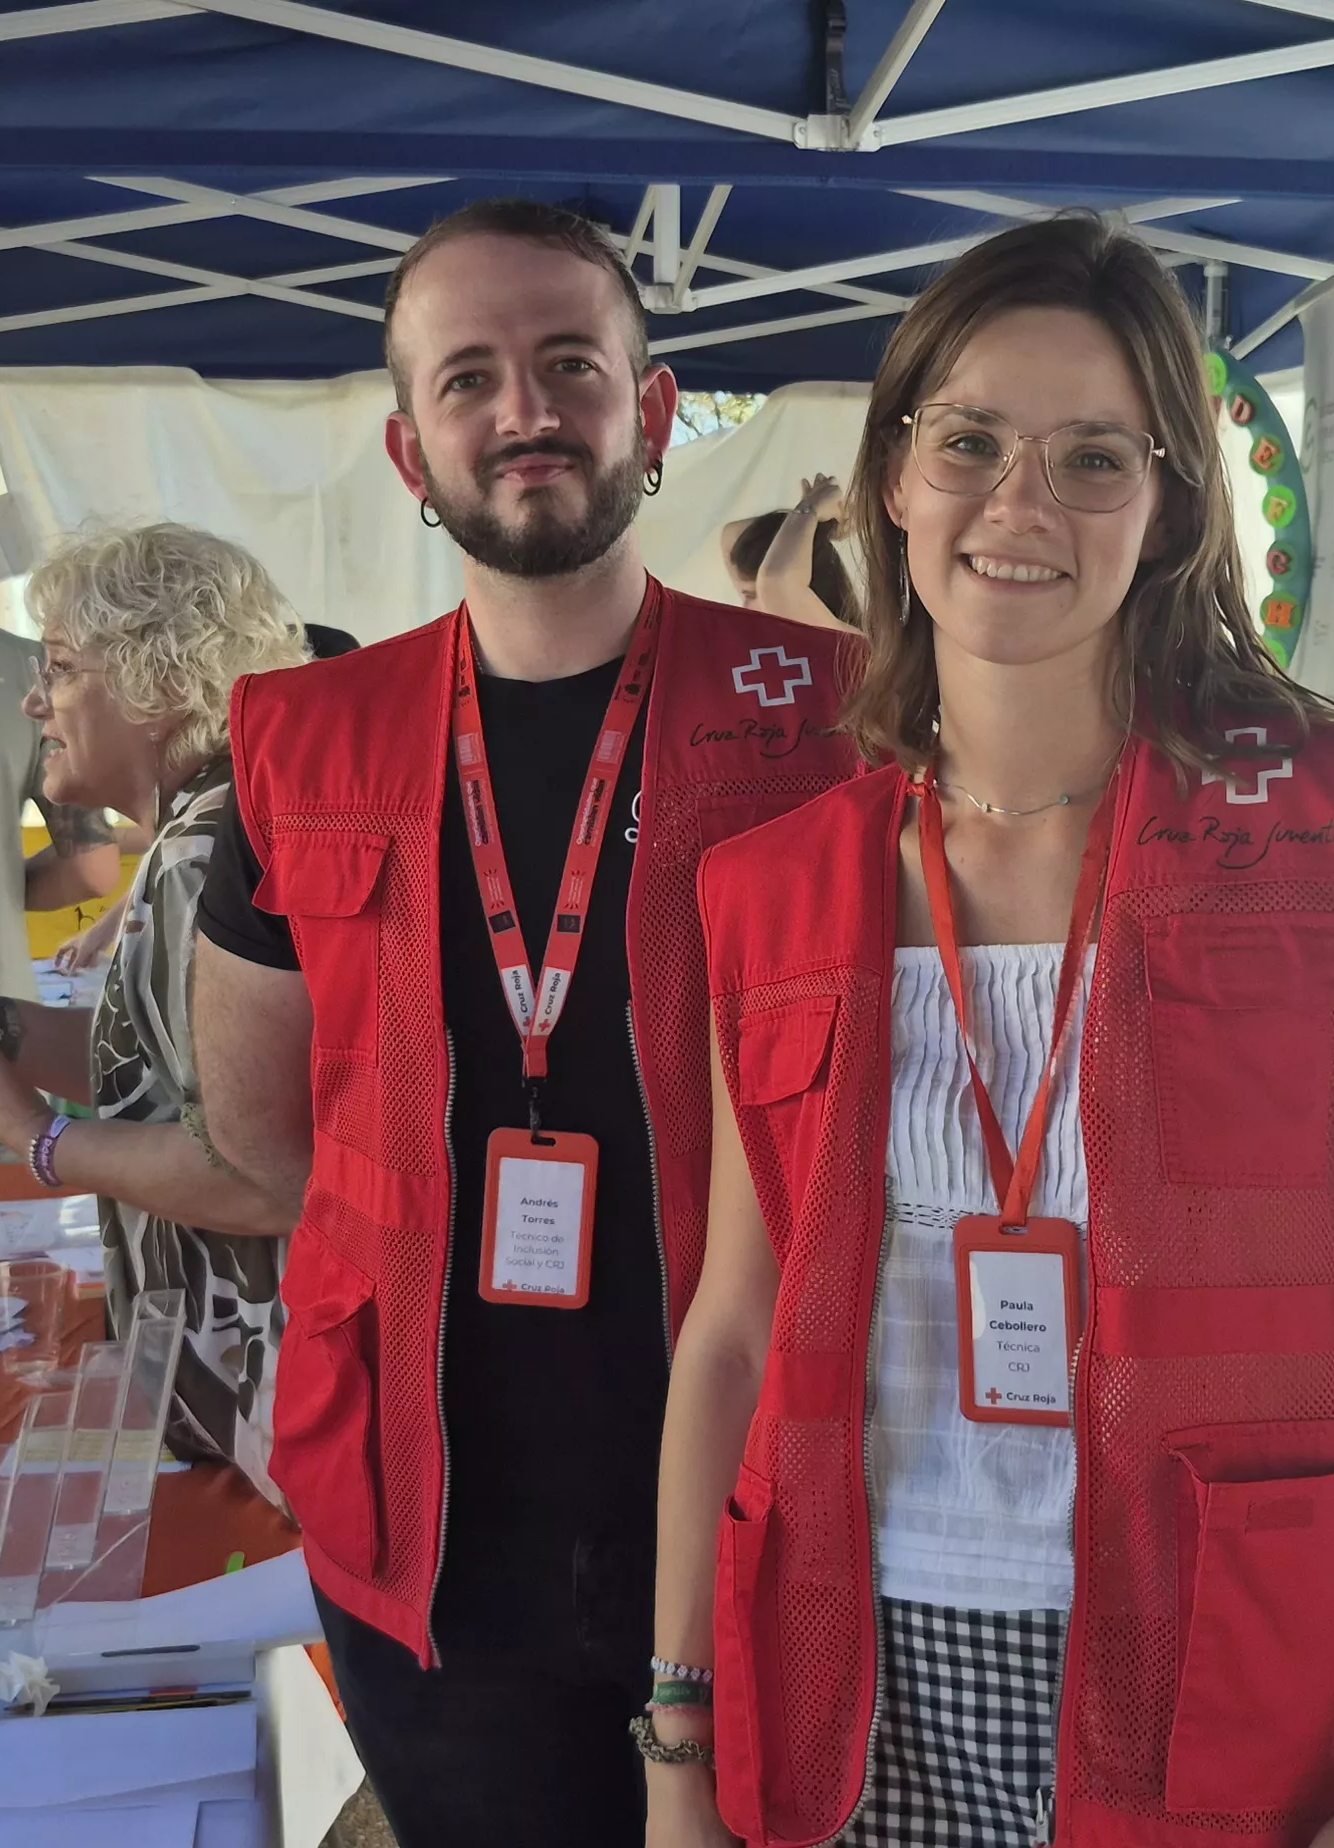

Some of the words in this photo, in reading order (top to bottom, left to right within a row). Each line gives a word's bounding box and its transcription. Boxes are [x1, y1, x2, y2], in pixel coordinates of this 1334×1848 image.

[511, 969, 523, 991] Roja
[549, 972, 561, 993] Roja
[517, 992, 529, 1013] Cruz
[545, 993, 556, 1015] Cruz
[520, 1197, 559, 1209] Andrés
[521, 1214, 555, 1225] Torres
[513, 1244, 559, 1256] Inclusión
[521, 1283, 542, 1292] Cruz
[544, 1284, 565, 1294] Roja
[1000, 1300, 1034, 1311] Paula
[989, 1320, 1047, 1332] Cebollero
[996, 1340, 1041, 1353] Técnica
[1006, 1392, 1030, 1402] Cruz
[1033, 1394, 1056, 1405] Roja
